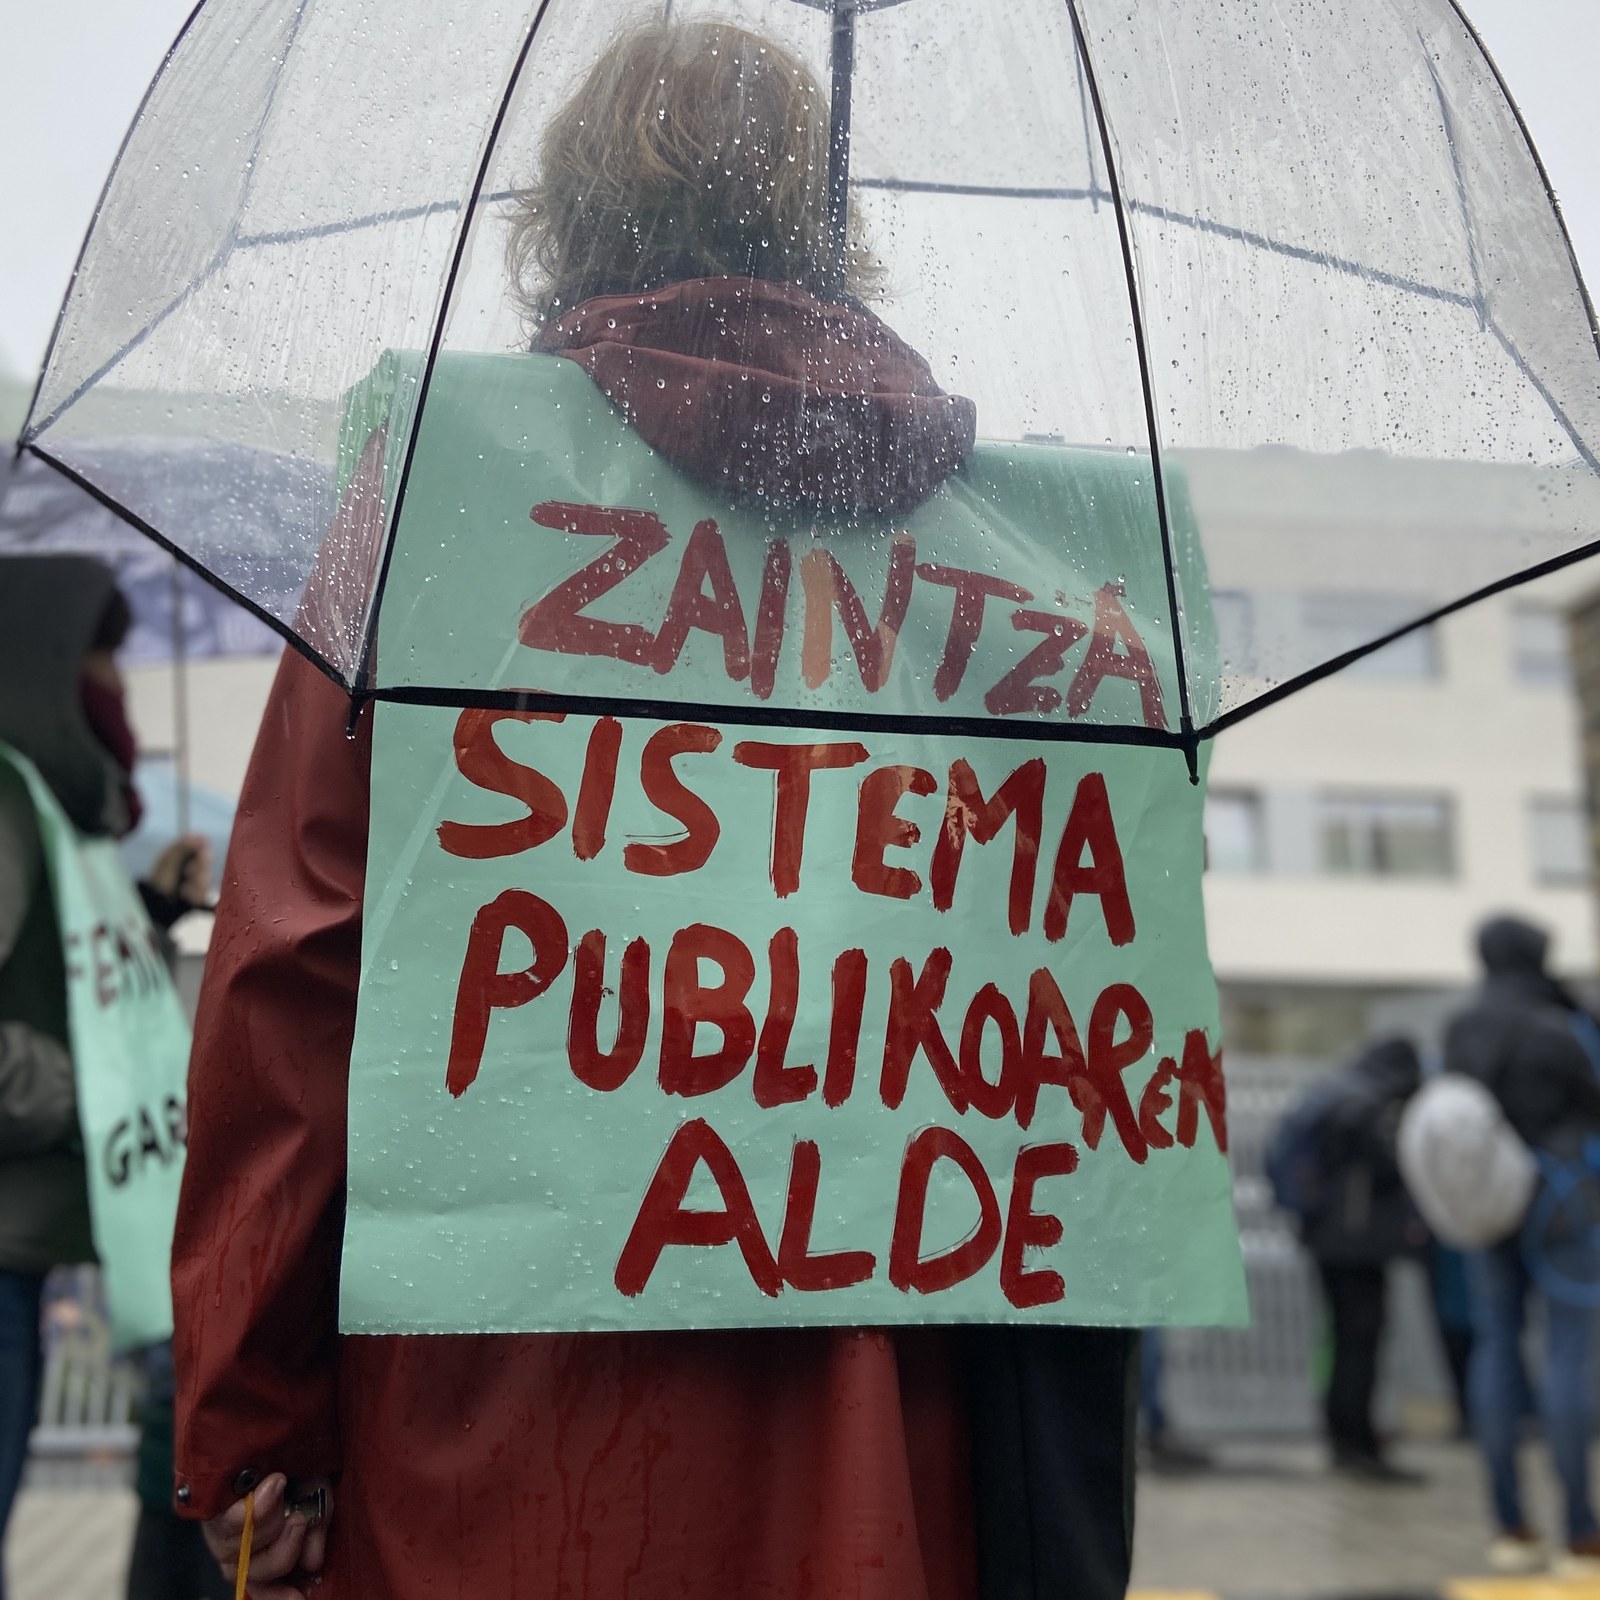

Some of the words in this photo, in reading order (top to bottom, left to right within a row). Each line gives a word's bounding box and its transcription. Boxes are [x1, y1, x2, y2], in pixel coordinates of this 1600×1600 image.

[519, 501, 1166, 730] ZAINTZA
[437, 688, 1136, 947] SISTEMA
[446, 889, 1228, 1163] PUBLIKOAREN
[615, 1117, 1080, 1309] ALDE
